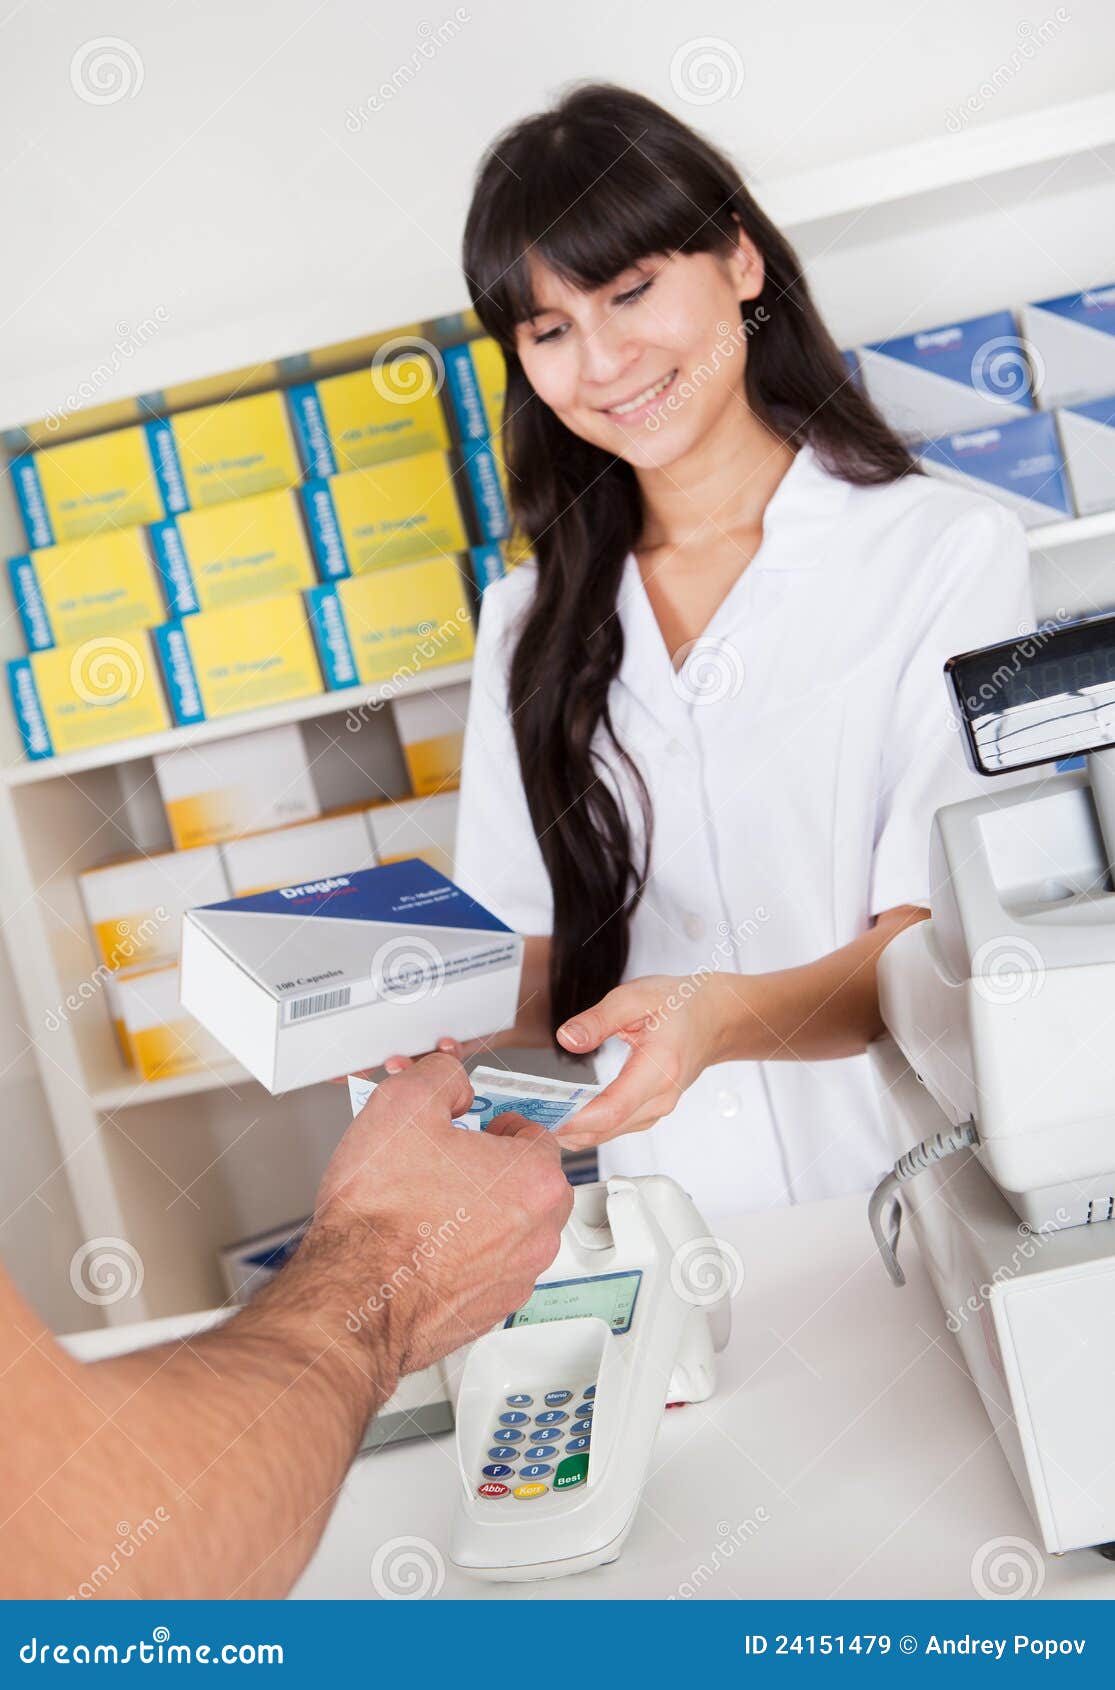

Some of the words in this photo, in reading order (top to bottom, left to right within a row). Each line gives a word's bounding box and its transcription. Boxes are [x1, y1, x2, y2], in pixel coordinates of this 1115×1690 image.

[279, 877, 351, 900] Dragée
[558, 1473, 581, 1485] Best
[481, 1484, 506, 1493] Abbr
[519, 1486, 542, 1495] Korr
